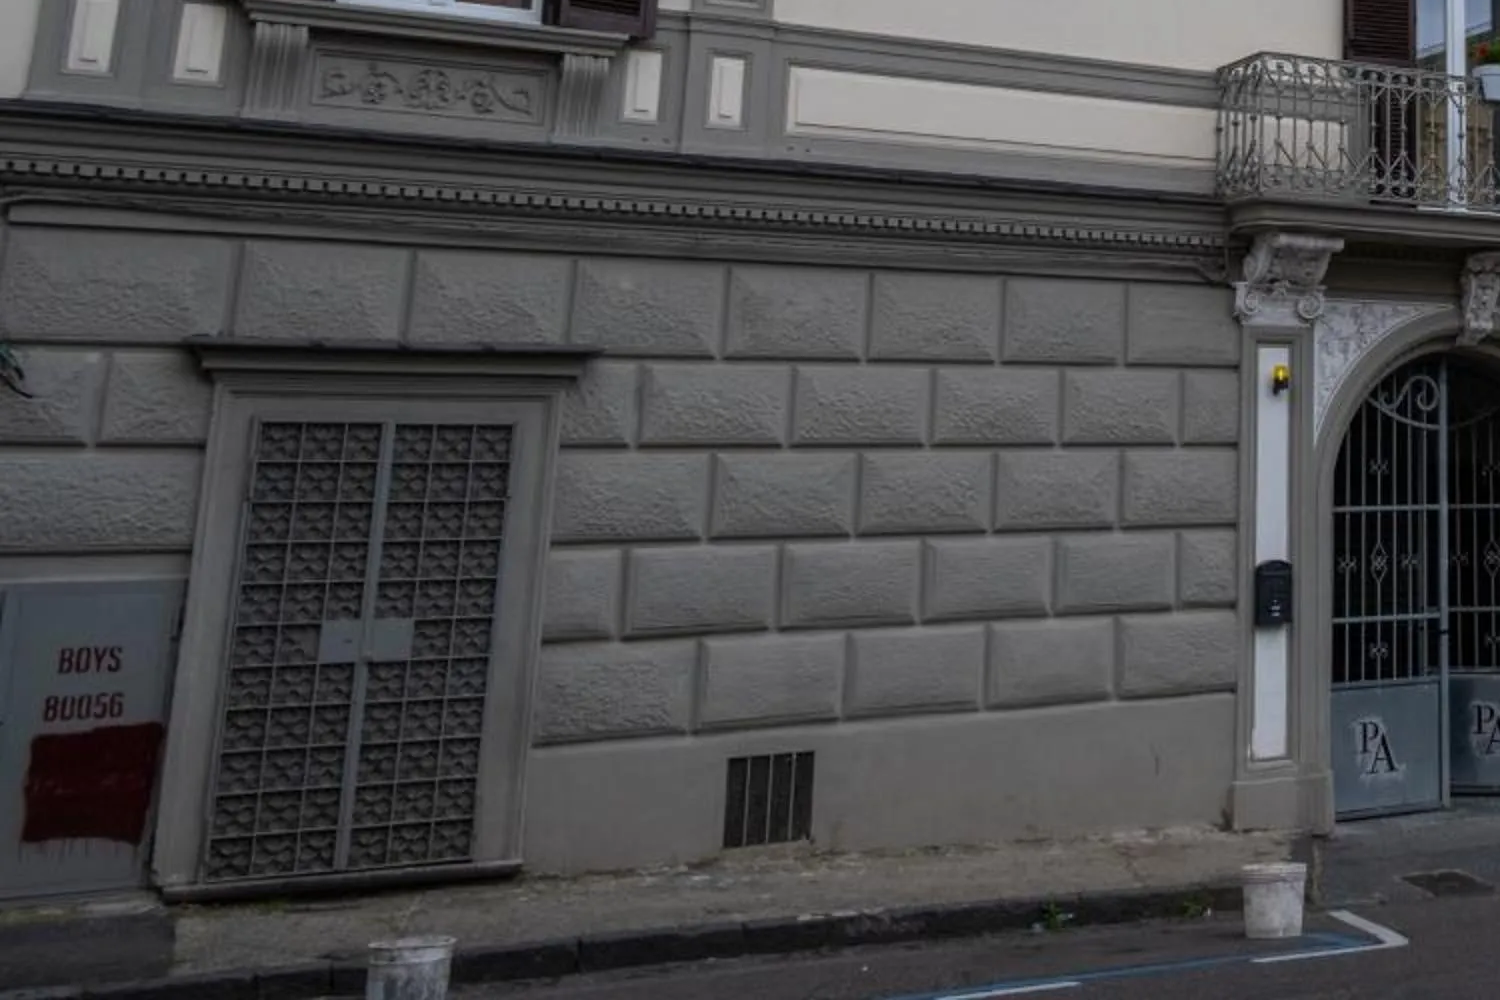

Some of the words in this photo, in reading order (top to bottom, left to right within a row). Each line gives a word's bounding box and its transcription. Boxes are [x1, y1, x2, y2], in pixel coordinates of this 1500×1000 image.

[57, 645, 123, 674] BOYS
[43, 691, 125, 722] 80056
[1359, 720, 1399, 774] PA
